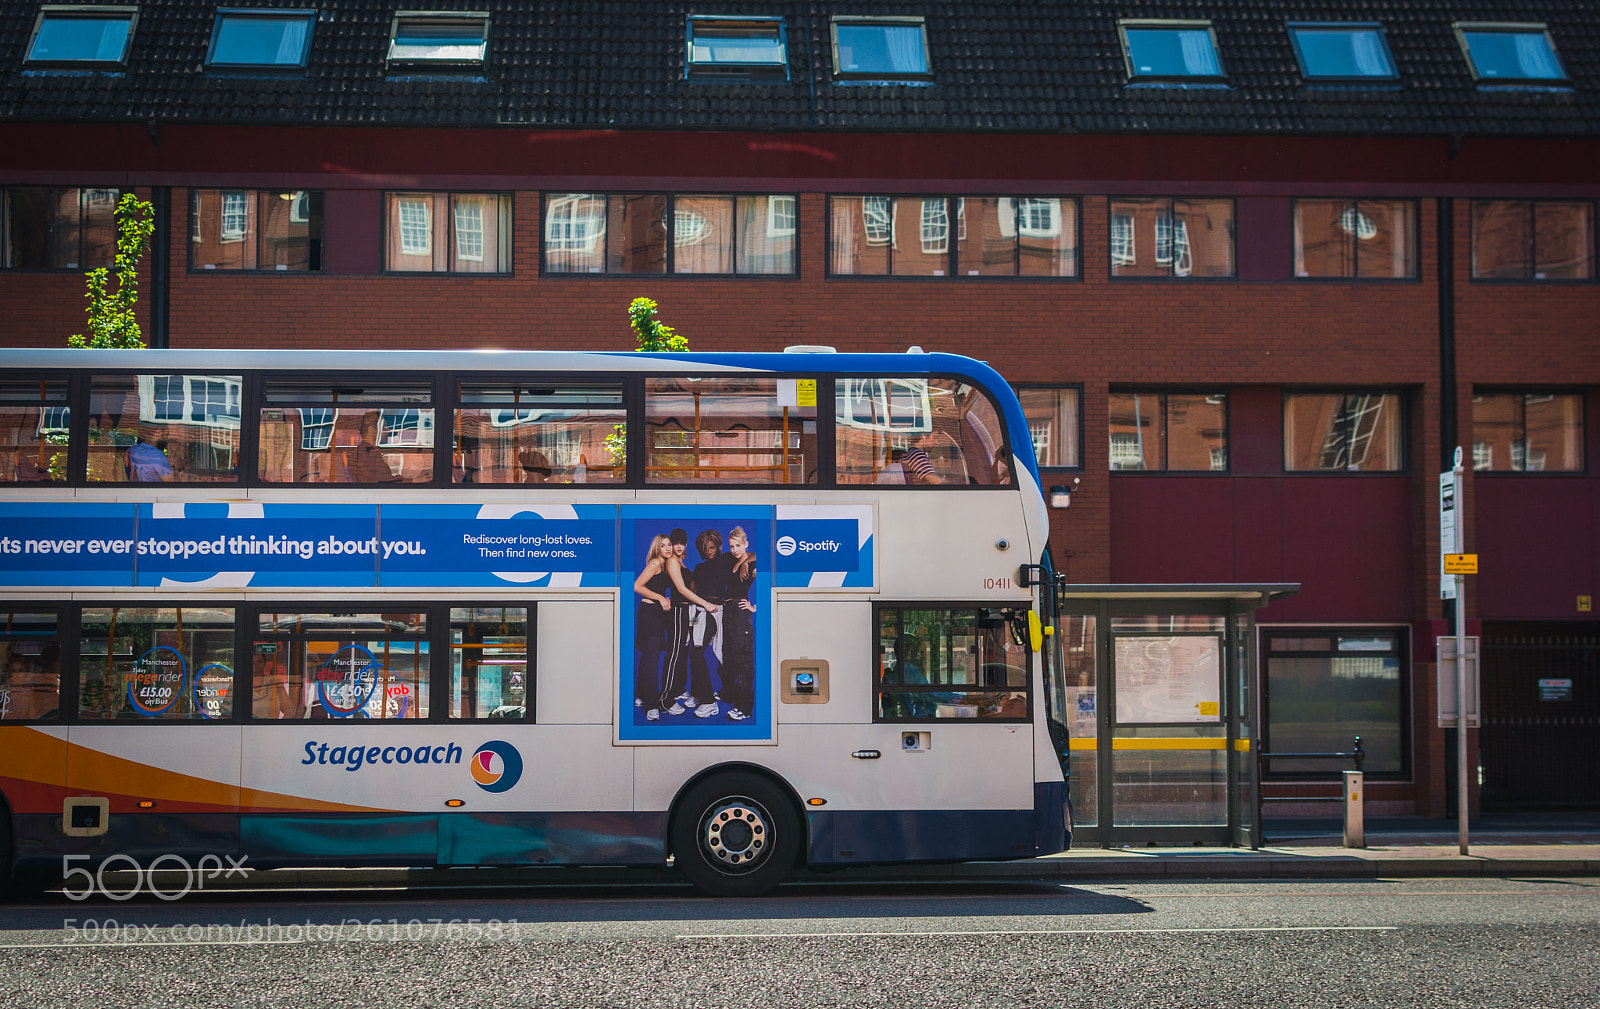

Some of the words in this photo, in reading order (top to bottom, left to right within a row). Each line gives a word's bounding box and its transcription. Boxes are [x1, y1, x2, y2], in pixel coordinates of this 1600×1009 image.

[0, 536, 22, 554] ts
[25, 539, 85, 554] never
[87, 539, 134, 554] ever
[137, 535, 225, 560] stopped
[228, 534, 314, 559] thinking
[317, 535, 379, 555] about
[382, 540, 427, 560] you.
[463, 534, 518, 544] Rediscover
[519, 534, 563, 547] long-lost
[565, 534, 593, 544] loves.
[798, 540, 840, 553] Spotify
[478, 548, 503, 558] Then
[505, 548, 525, 558] find
[984, 578, 1010, 589] 10411
[125, 671, 183, 685] megarider
[317, 668, 373, 684] dayrider
[140, 687, 172, 698] £15.00
[301, 741, 463, 772] Stagecoach
